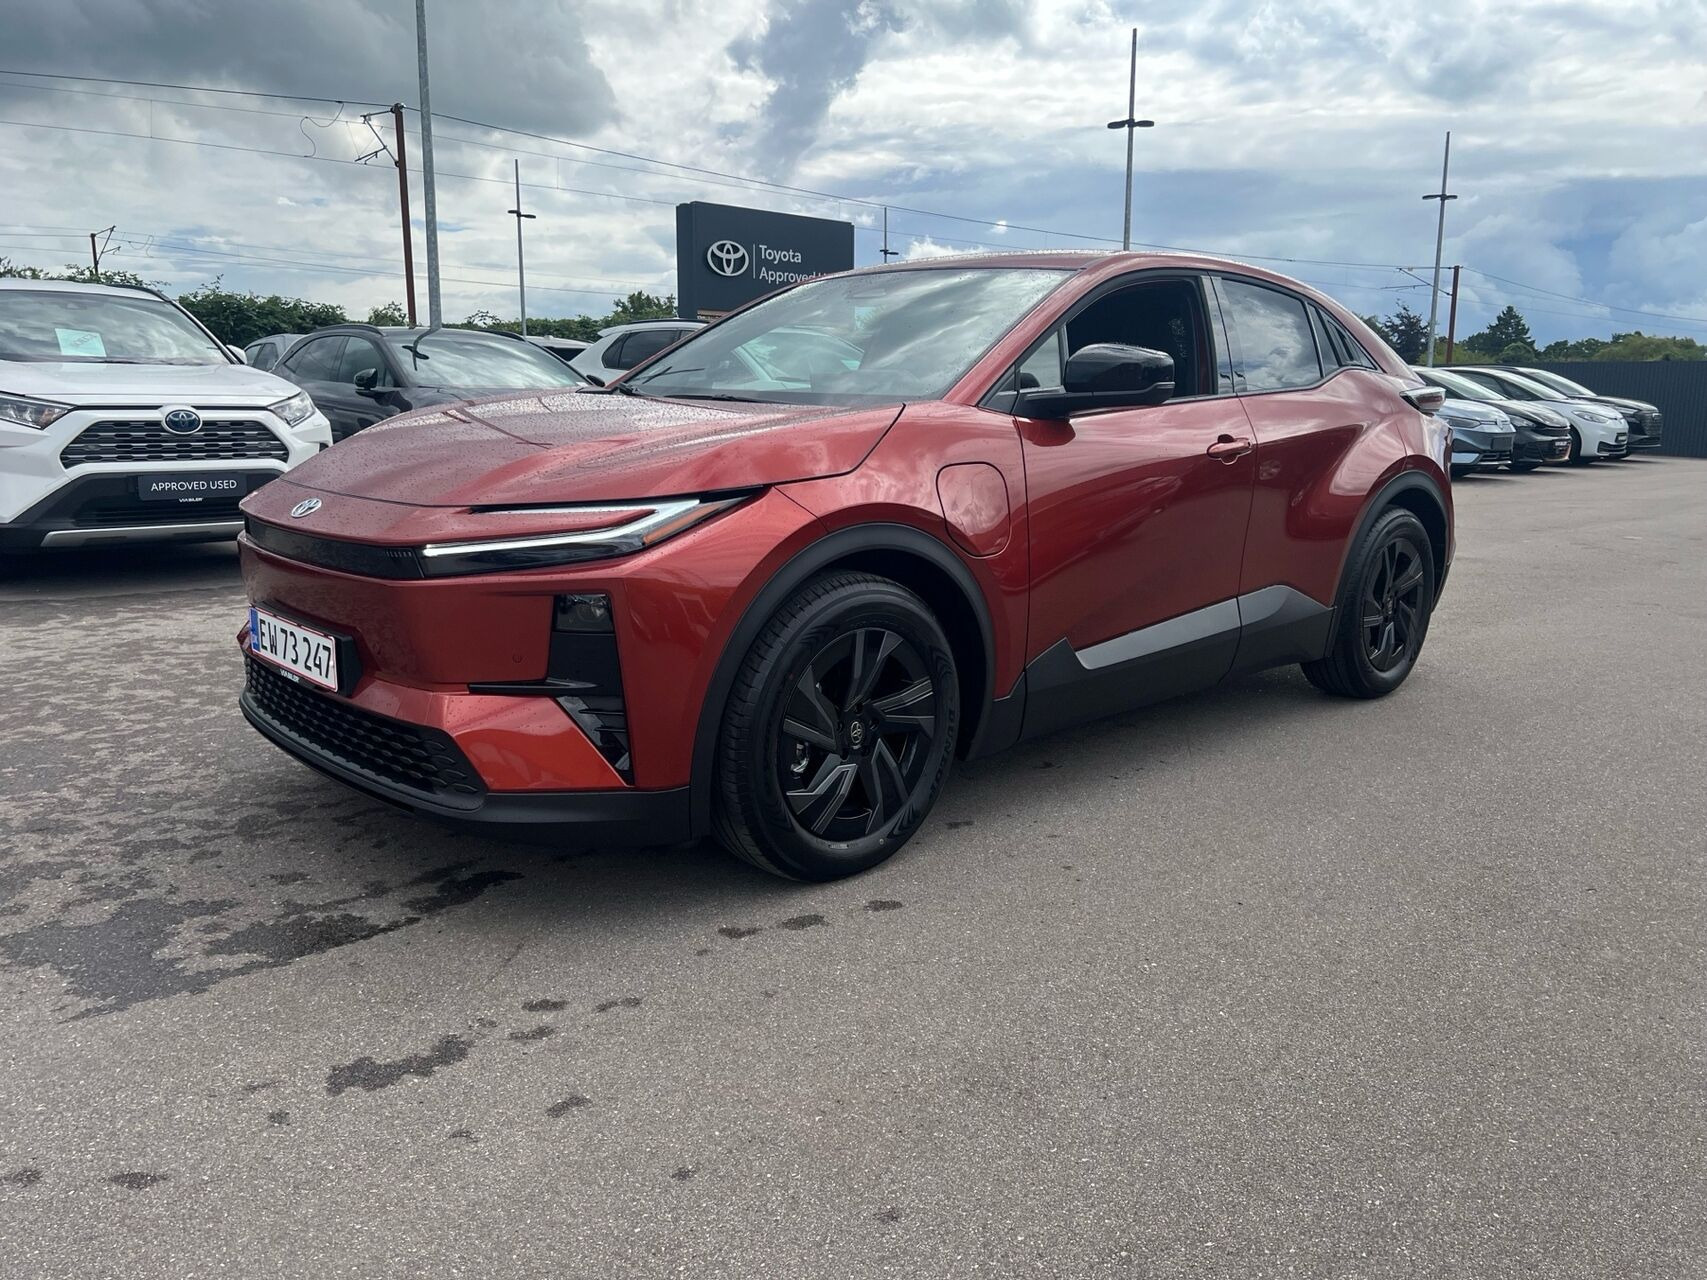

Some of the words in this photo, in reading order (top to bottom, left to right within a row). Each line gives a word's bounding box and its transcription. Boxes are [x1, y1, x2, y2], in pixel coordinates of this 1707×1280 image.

[759, 244, 802, 264] Toyota
[150, 481, 207, 491] APPROVED
[209, 480, 237, 490] USED
[259, 618, 278, 656] EW
[280, 627, 299, 665] 73
[302, 636, 332, 679] 247
